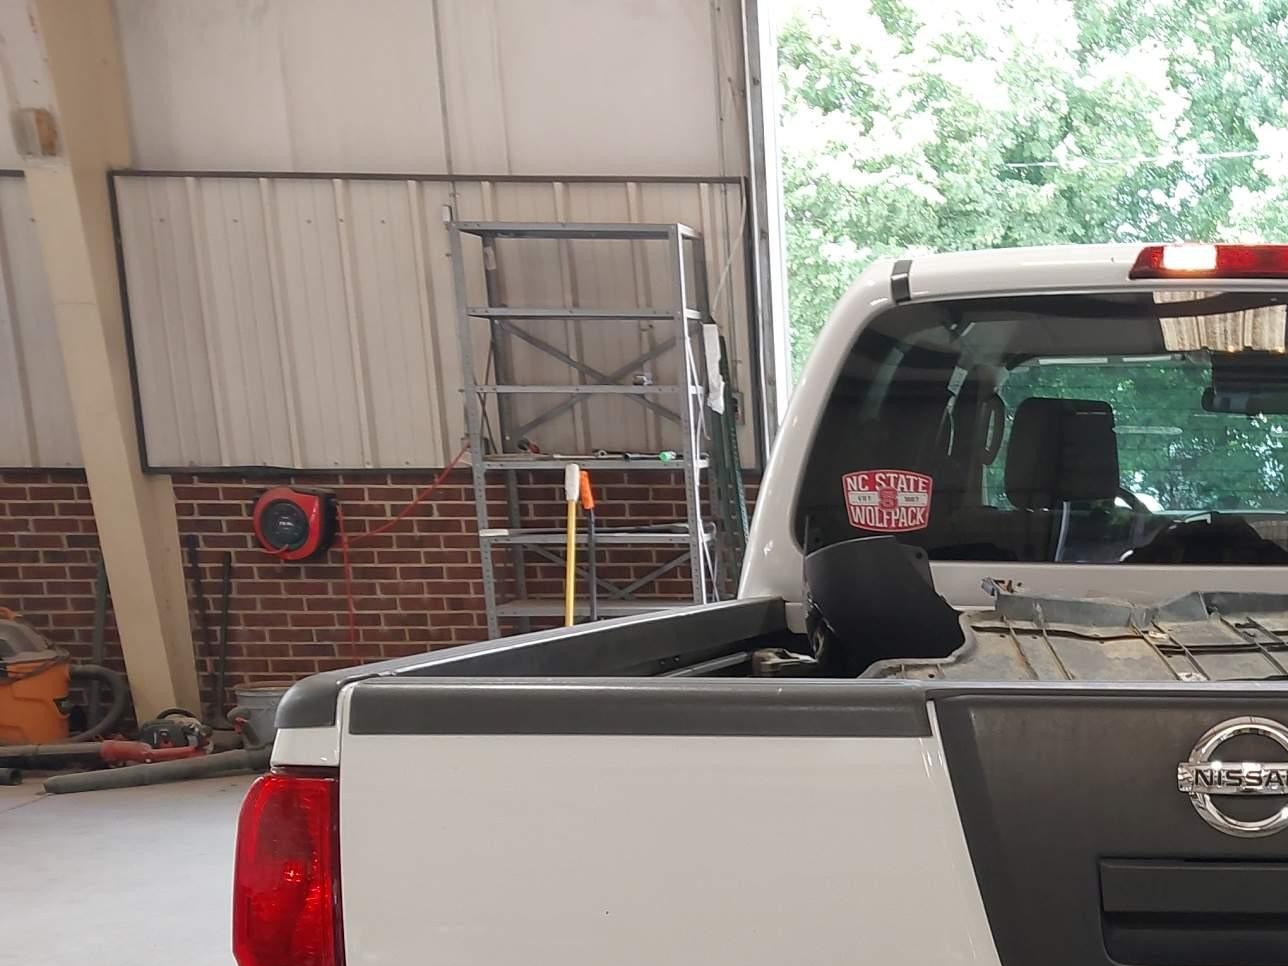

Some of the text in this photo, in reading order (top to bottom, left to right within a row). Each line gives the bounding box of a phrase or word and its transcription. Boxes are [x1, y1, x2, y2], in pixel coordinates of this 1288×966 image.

[846, 473, 929, 492] NC STATE
[850, 506, 927, 528] WOLFPACK
